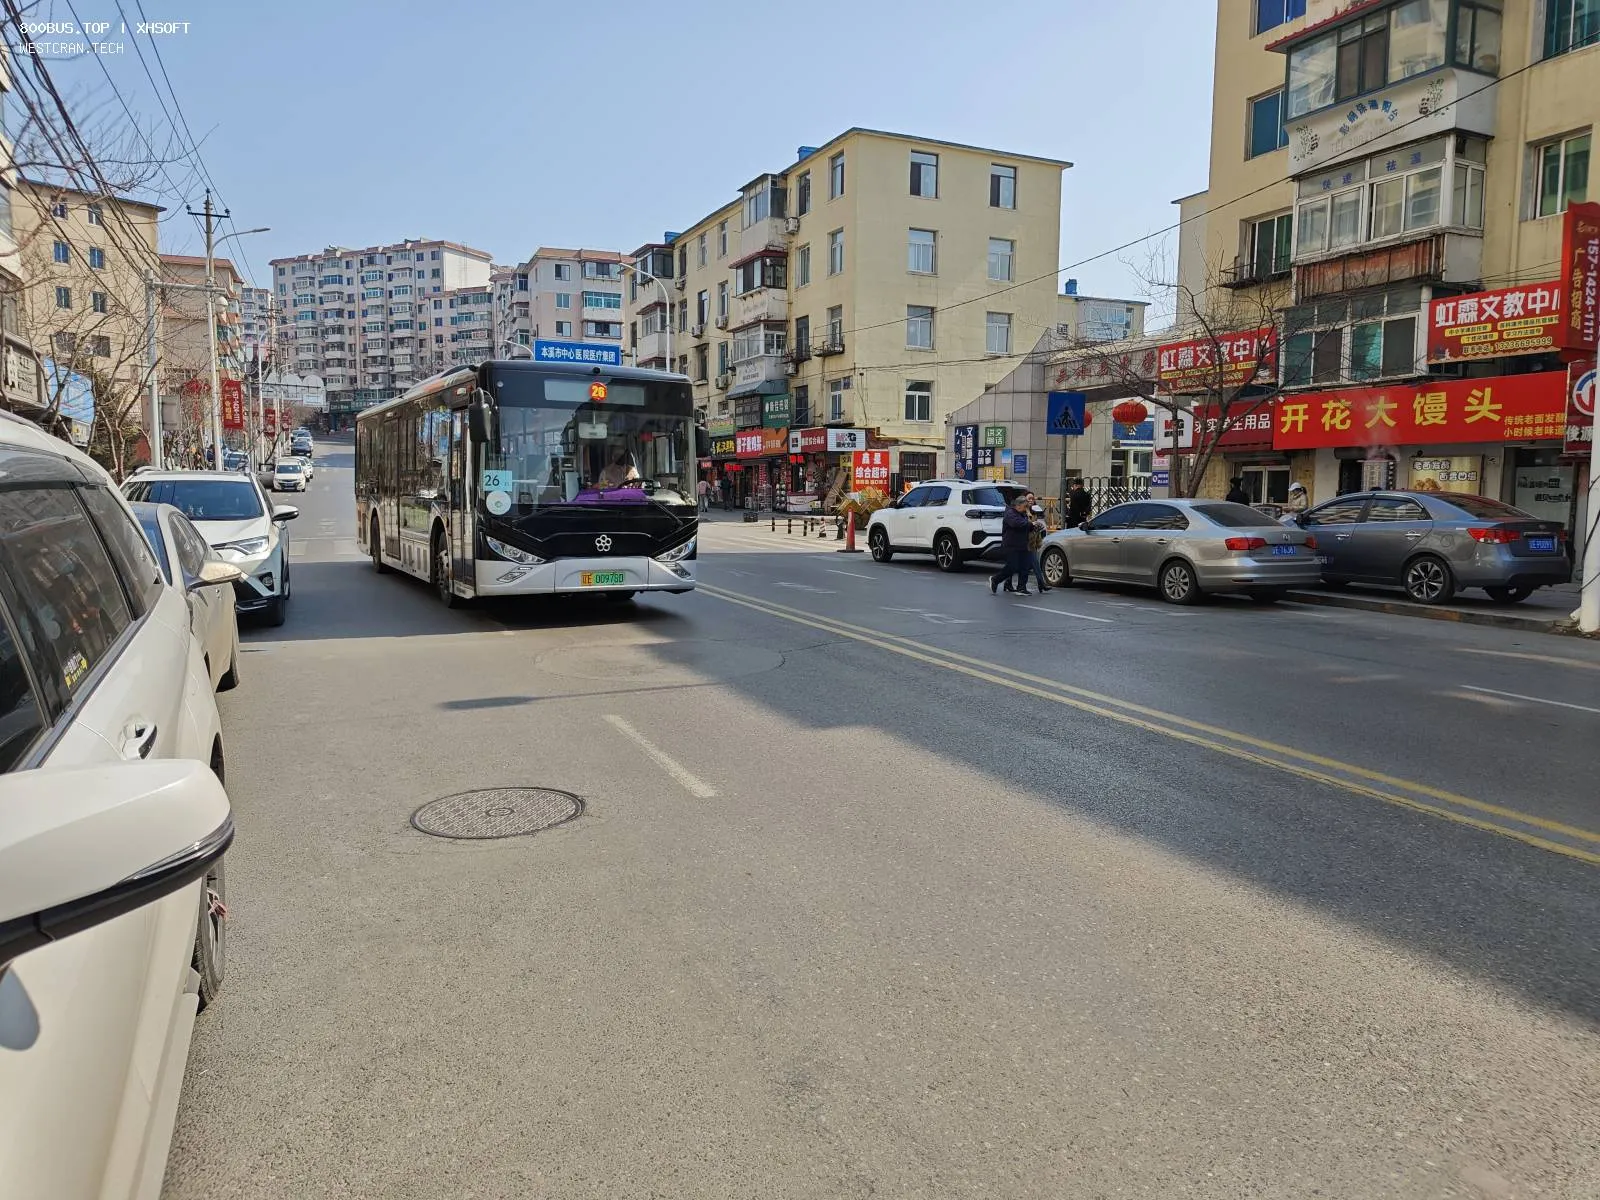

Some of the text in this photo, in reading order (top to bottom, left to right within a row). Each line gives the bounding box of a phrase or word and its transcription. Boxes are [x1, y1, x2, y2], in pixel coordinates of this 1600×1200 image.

[1583, 239, 1599, 342] 157-1424-1111
[541, 346, 616, 362] 本溪市中心医院医疗集团
[591, 385, 605, 398] 26
[1281, 387, 1503, 434] 开花大馒头
[1504, 412, 1566, 425] 传统老面发酵
[1504, 425, 1566, 438] 小时候老味道
[855, 466, 888, 479] 综合超市
[484, 474, 500, 487] 26
